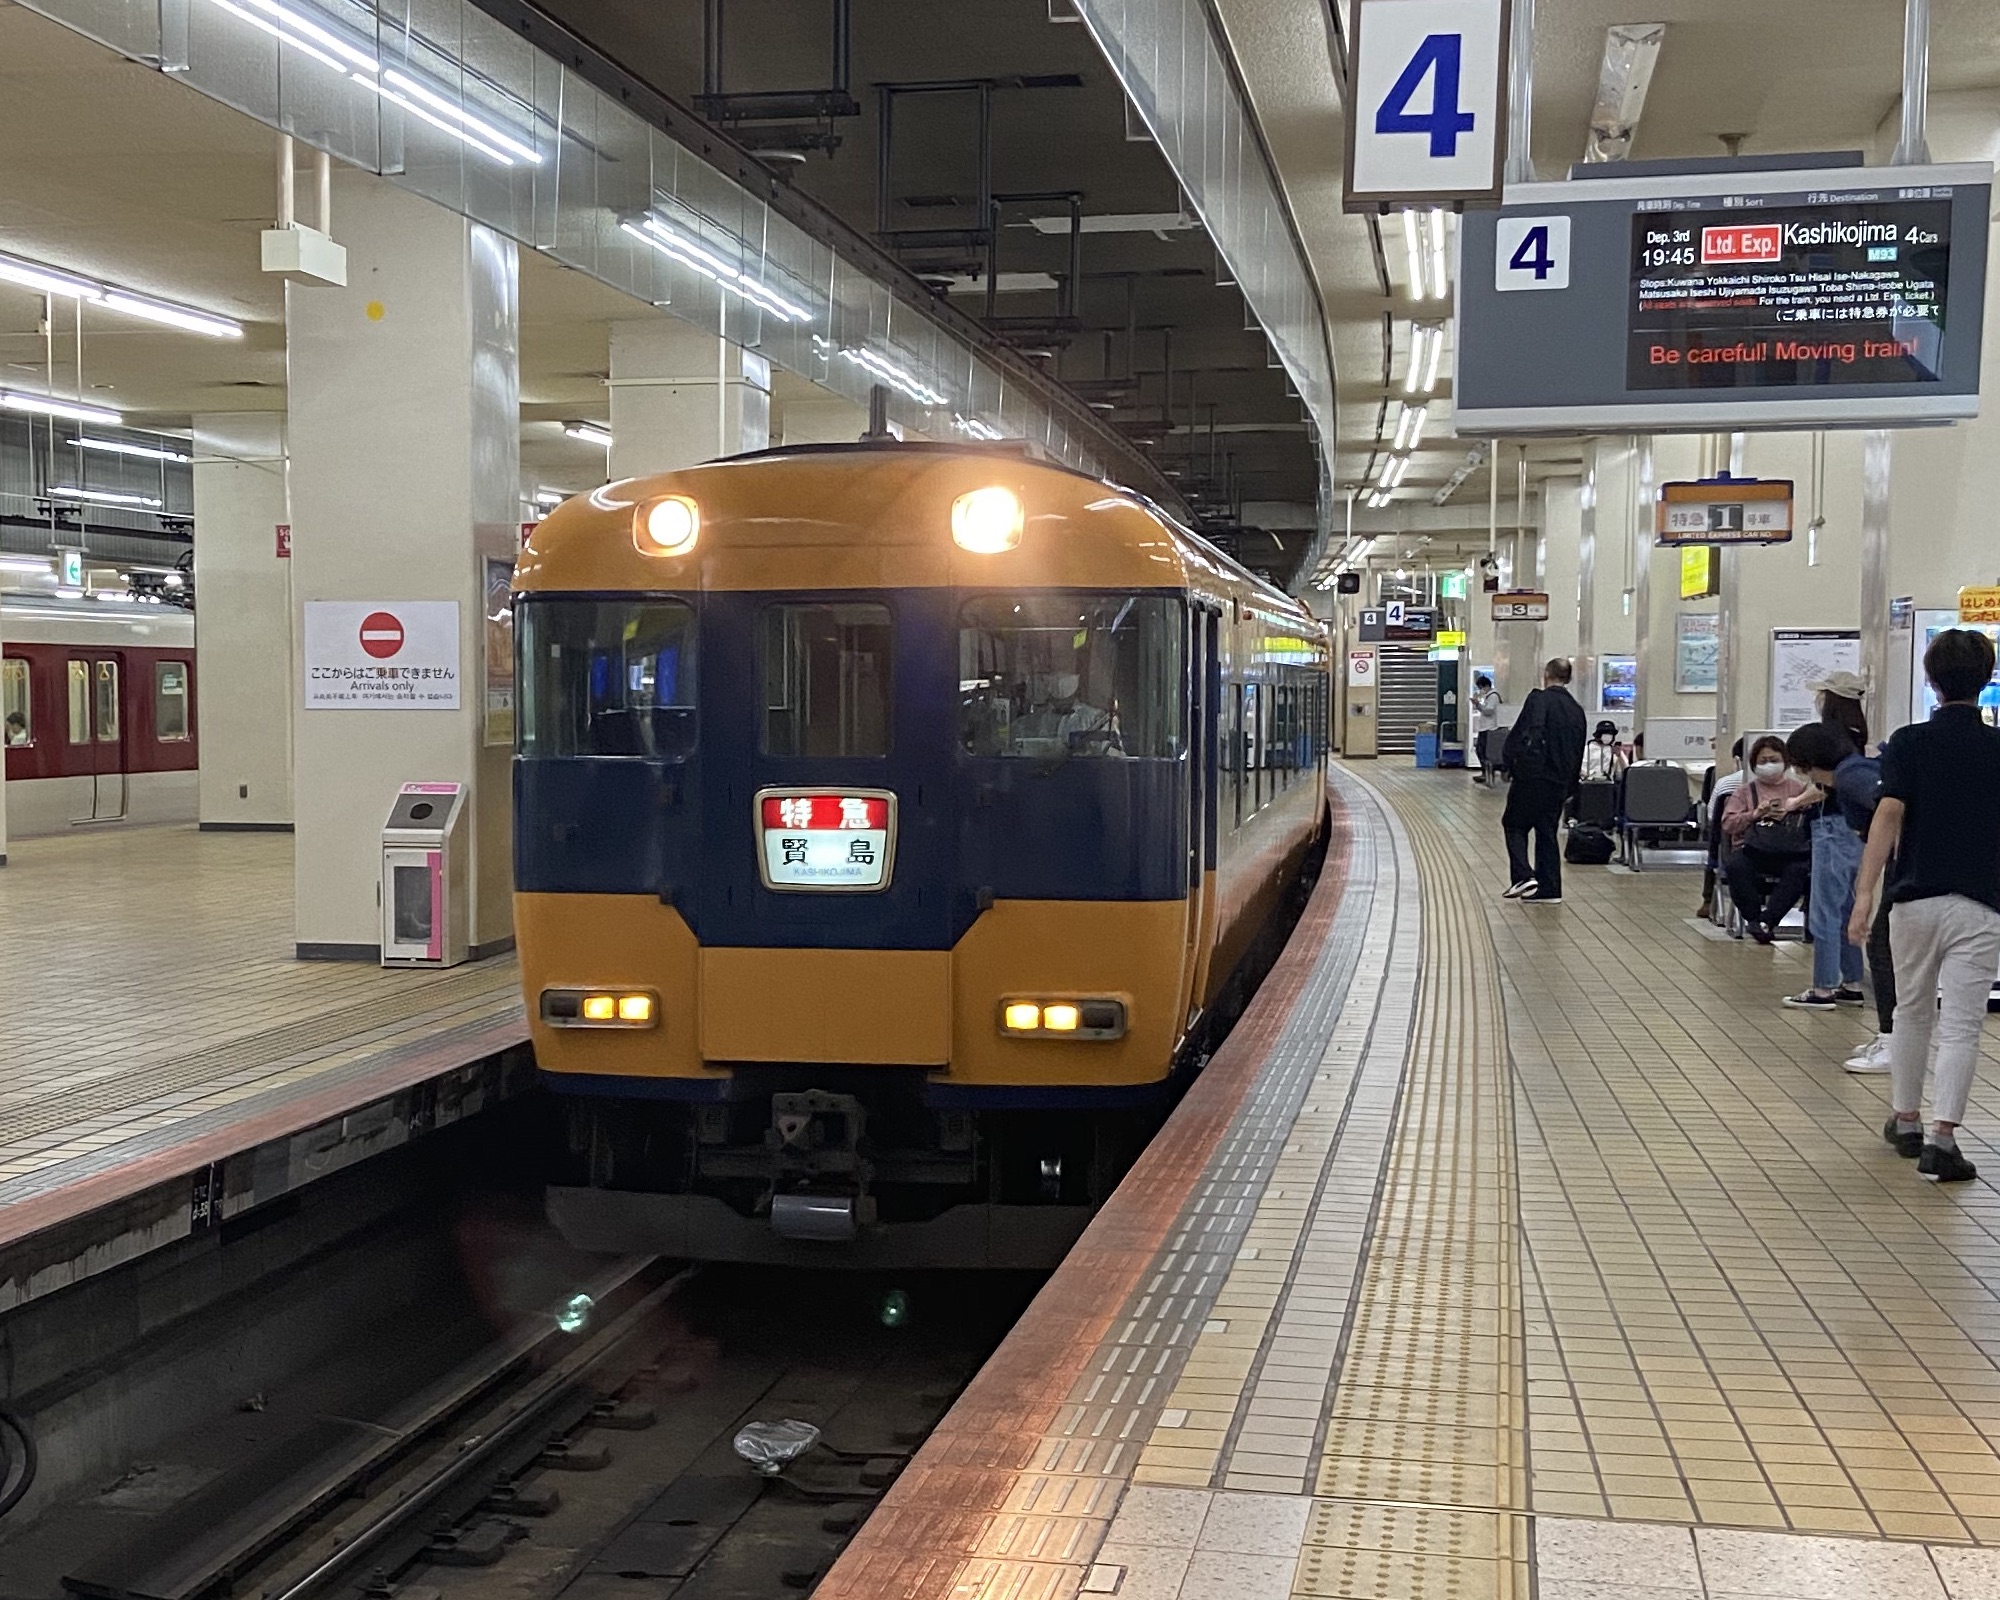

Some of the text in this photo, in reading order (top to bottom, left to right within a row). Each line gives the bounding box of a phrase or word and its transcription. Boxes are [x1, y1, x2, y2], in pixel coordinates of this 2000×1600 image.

[1375, 34, 1474, 157] 4
[1647, 230, 1691, 245] Dep. 3rd
[1784, 220, 1897, 247] Kashikojima
[1904, 226, 1919, 244] 4
[1510, 226, 1554, 279] 4
[1707, 233, 1776, 257] Ltd. Exp.
[1642, 247, 1695, 267] 19:45
[1867, 248, 1896, 262] M93
[1706, 276, 1750, 286] Yokkaichi
[1752, 274, 1787, 284] Shiroko
[1790, 273, 1806, 282] Tsu
[1808, 272, 1832, 281] Hisai
[1834, 271, 1900, 281] Ise-Nakagawa
[1640, 289, 1688, 299] Matsusaka
[1690, 287, 1717, 297] Iseshi
[1719, 286, 1766, 297] Ujiyamada
[1769, 284, 1817, 295] Isuzugawa
[1820, 283, 1843, 292] Toba
[1906, 280, 1934, 291] Ugata
[1759, 297, 1774, 306] For
[1776, 296, 1790, 304] the
[1815, 294, 1831, 304] you
[1833, 293, 1854, 302] need
[1650, 338, 1918, 365] Be careful! Moving train!
[1715, 507, 1734, 529] 1
[1389, 605, 1402, 621] 4
[1512, 604, 1527, 615] 3
[311, 668, 455, 679] ここからはご乗車できません
[350, 680, 414, 692] Arrivals only
[780, 798, 871, 828] 特急
[782, 839, 875, 865] 賢島
[794, 867, 862, 876] KASHIKOJIMA
